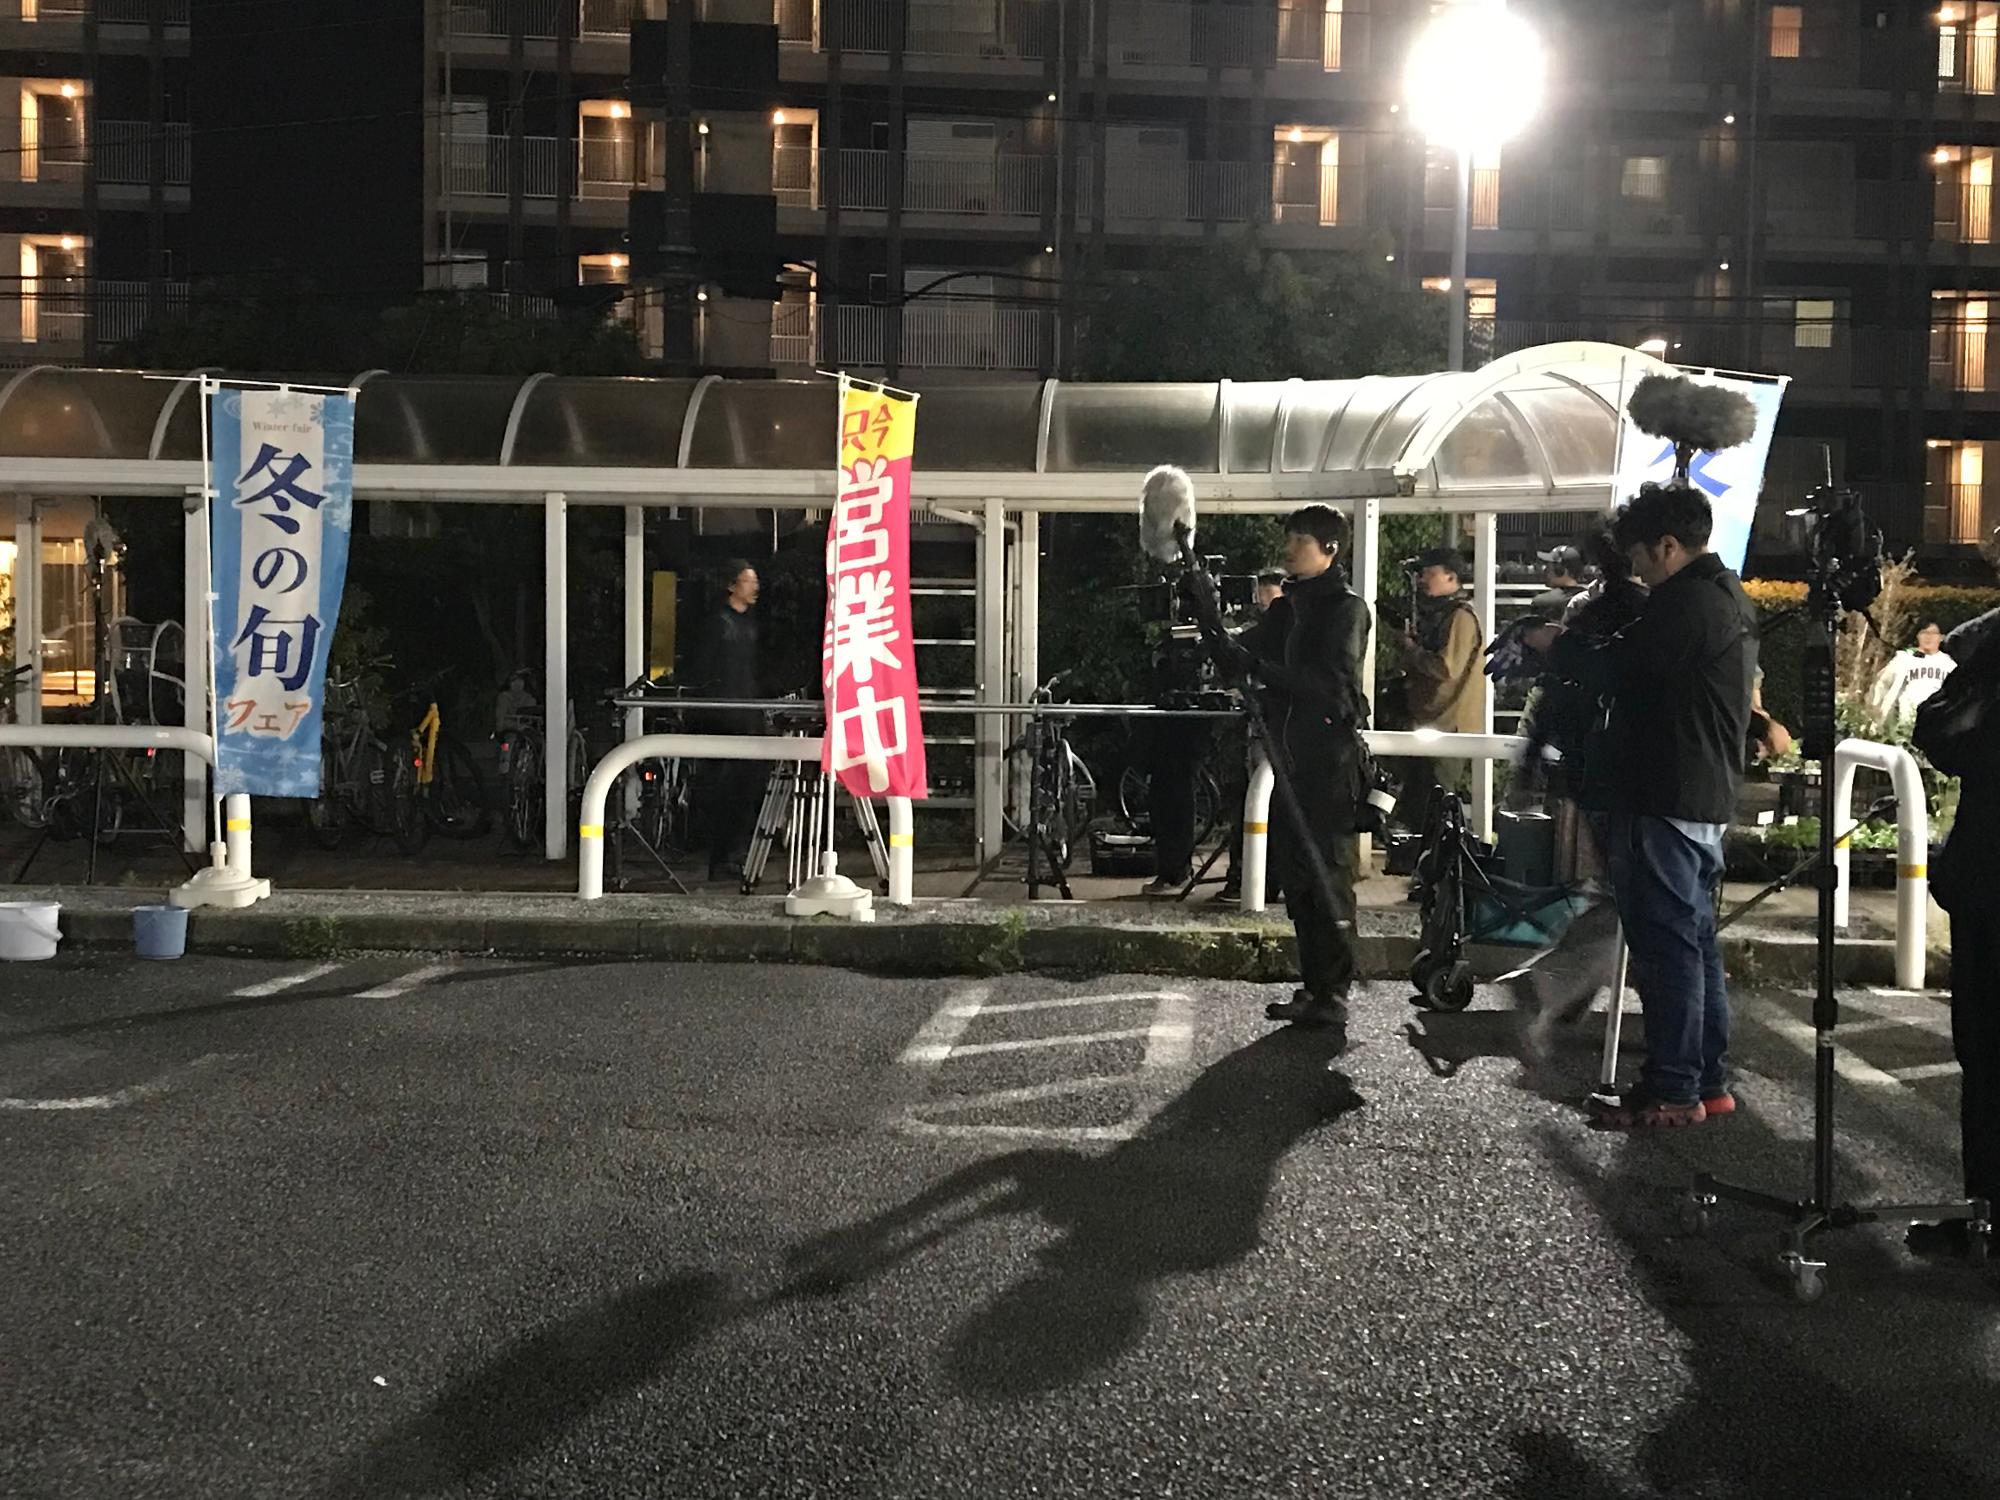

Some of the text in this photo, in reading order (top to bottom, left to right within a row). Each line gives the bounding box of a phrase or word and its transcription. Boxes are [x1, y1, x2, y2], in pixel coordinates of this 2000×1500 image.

[842, 404, 893, 451] 只今
[234, 443, 327, 691] 冬の旬
[824, 456, 908, 793] 営業中
[228, 700, 309, 736] フェア
